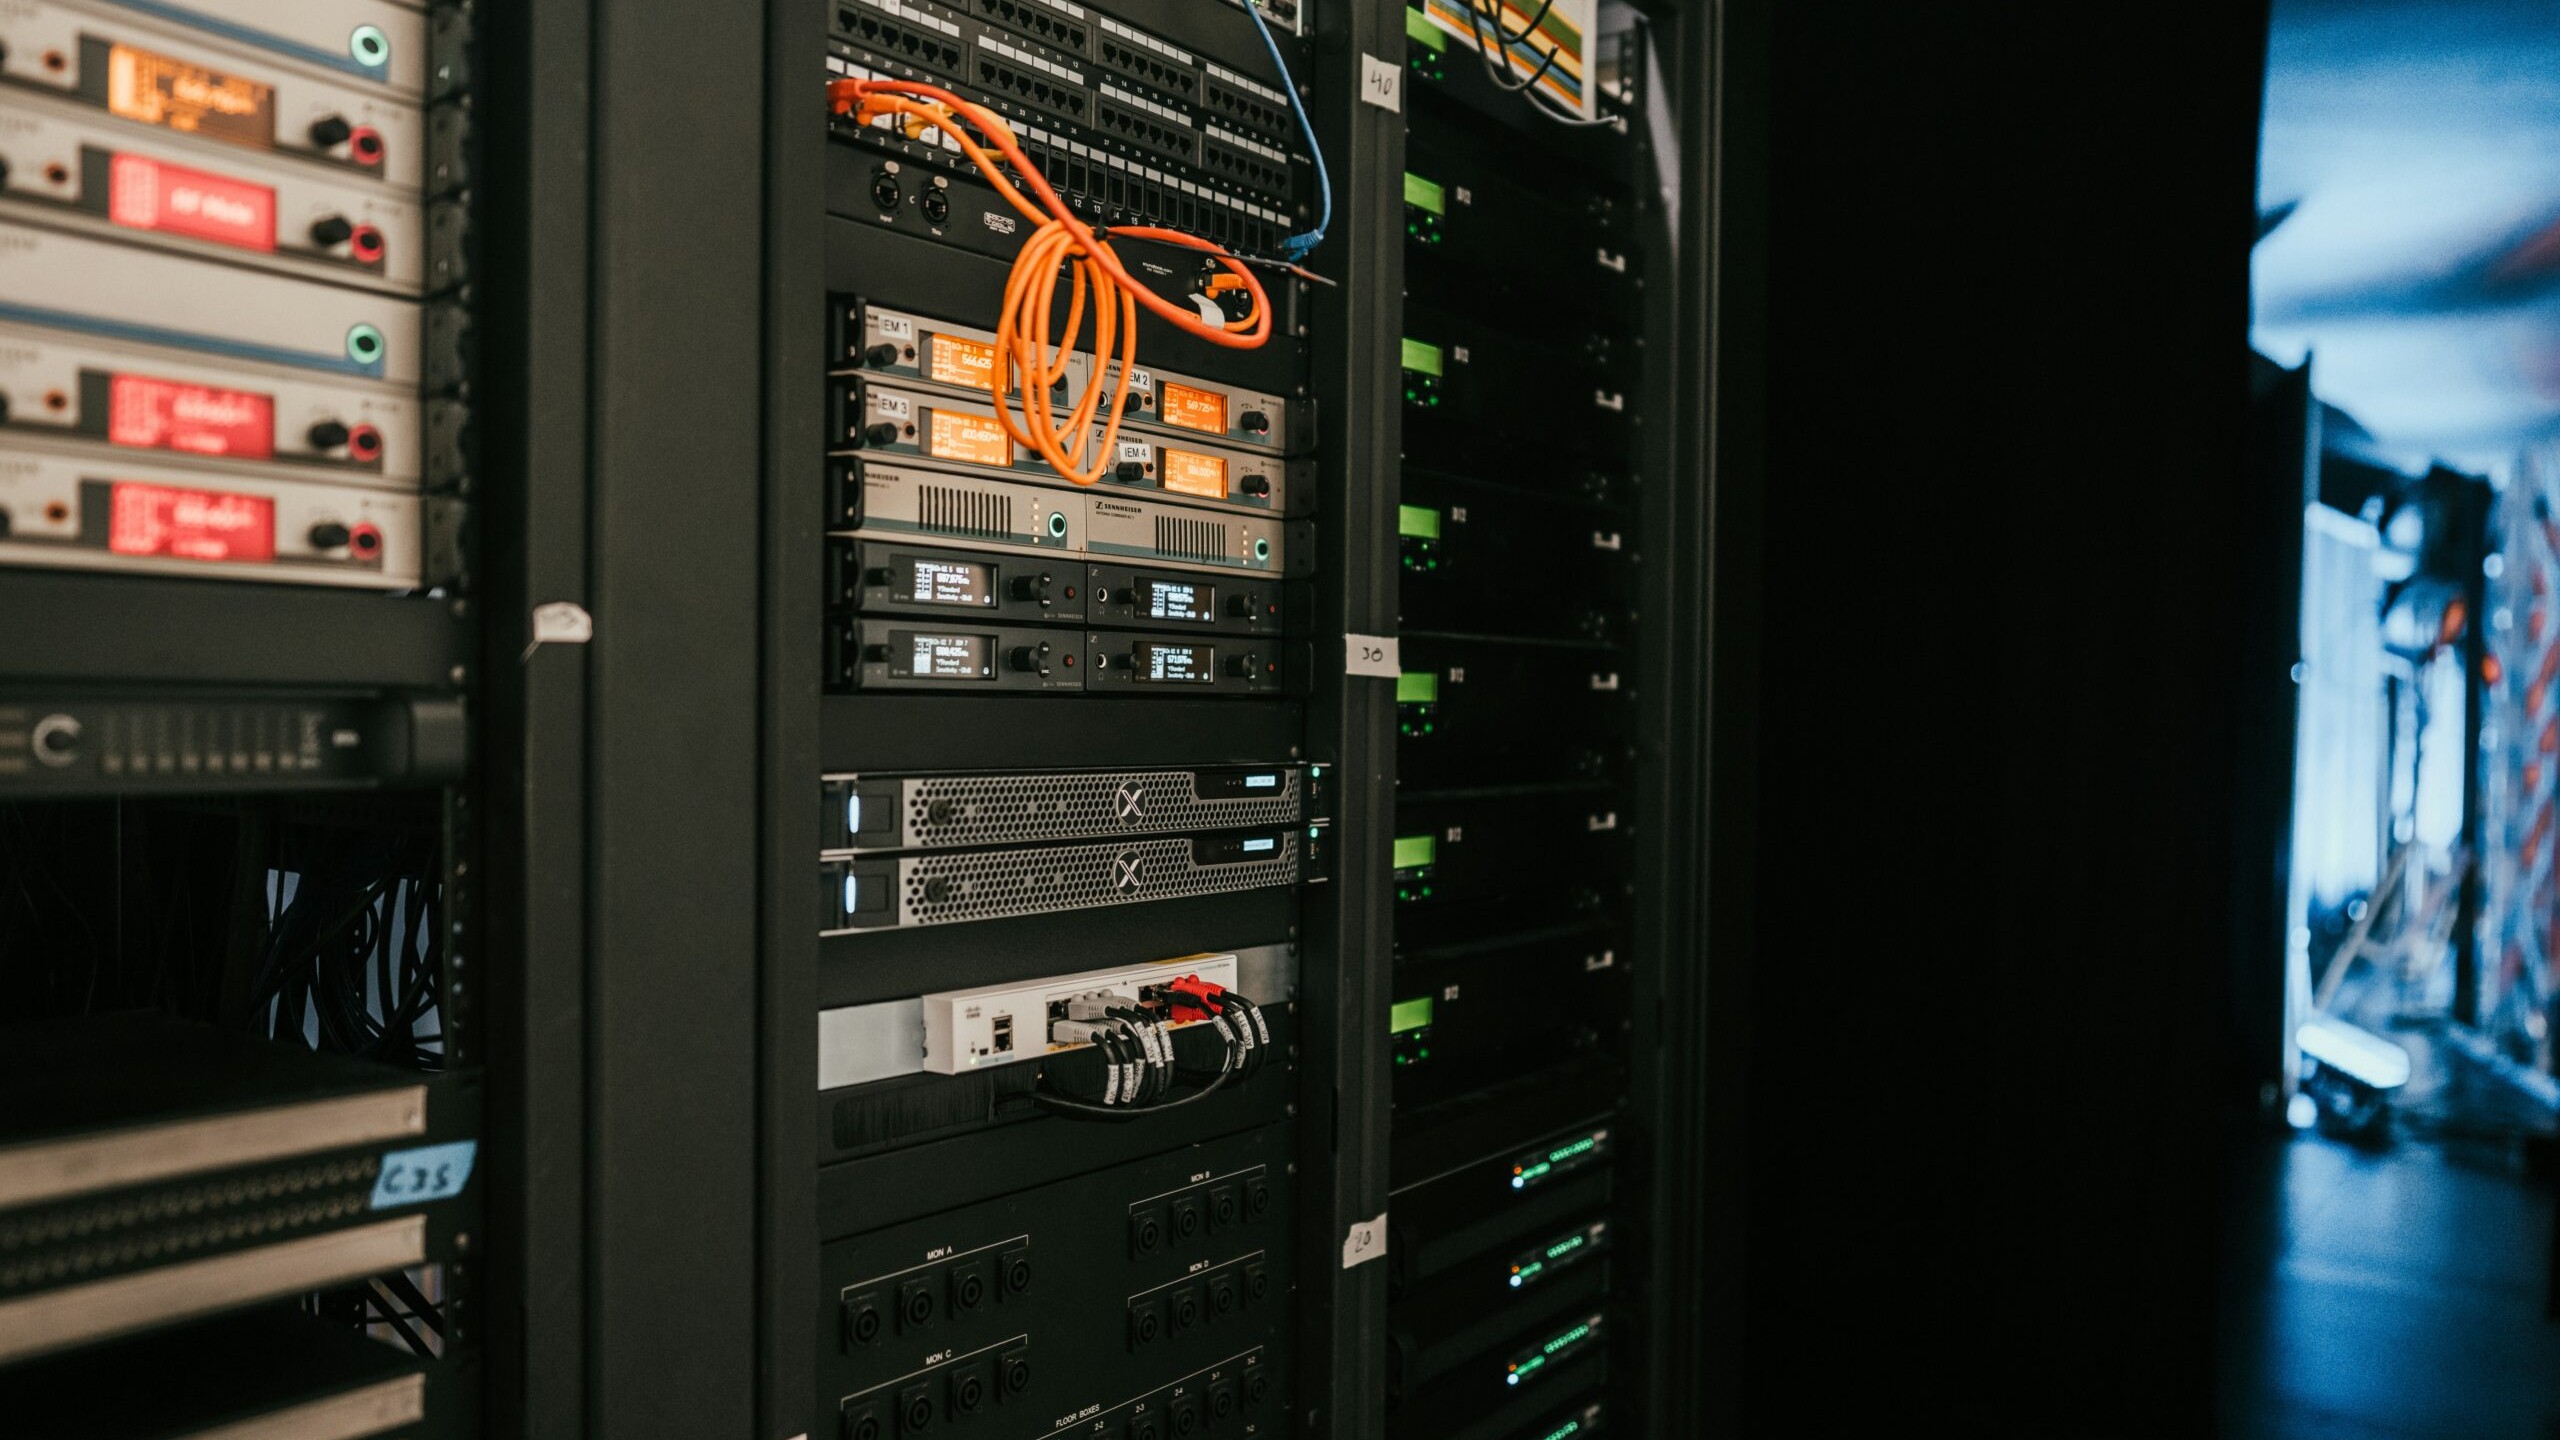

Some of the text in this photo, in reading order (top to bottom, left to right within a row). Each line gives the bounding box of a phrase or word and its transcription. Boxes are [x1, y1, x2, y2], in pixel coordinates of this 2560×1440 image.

[1371, 70, 1392, 95] 40
[1001, 102, 1008, 110] 32
[854, 129, 860, 138] 2
[879, 137, 885, 146] 3
[904, 145, 909, 153] 4
[926, 152, 932, 161] 5
[950, 160, 955, 168] 6
[972, 166, 977, 174] 7
[1015, 180, 1020, 188] 9
[1074, 200, 1082, 208] 12
[1094, 205, 1100, 214] 13
[1132, 217, 1138, 226] 15
[909, 196, 915, 204] C
[904, 322, 909, 334] 1
[1130, 372, 1148, 385] EM 2
[878, 398, 907, 414] IEM 3
[1125, 446, 1146, 458] IEM 4
[1104, 503, 1142, 514] SENNHEISER
[1362, 646, 1383, 662] 30
[382, 1163, 450, 1194] C35
[1191, 1173, 1204, 1183] MON
[927, 1246, 953, 1260] MON A
[926, 1349, 951, 1365] MON C
[1174, 1387, 1184, 1397] 2-4
[1135, 1404, 1145, 1414] 2-3
[1056, 1404, 1100, 1428] FLOOR BOXES
[1094, 1420, 1105, 1431] 2-2
